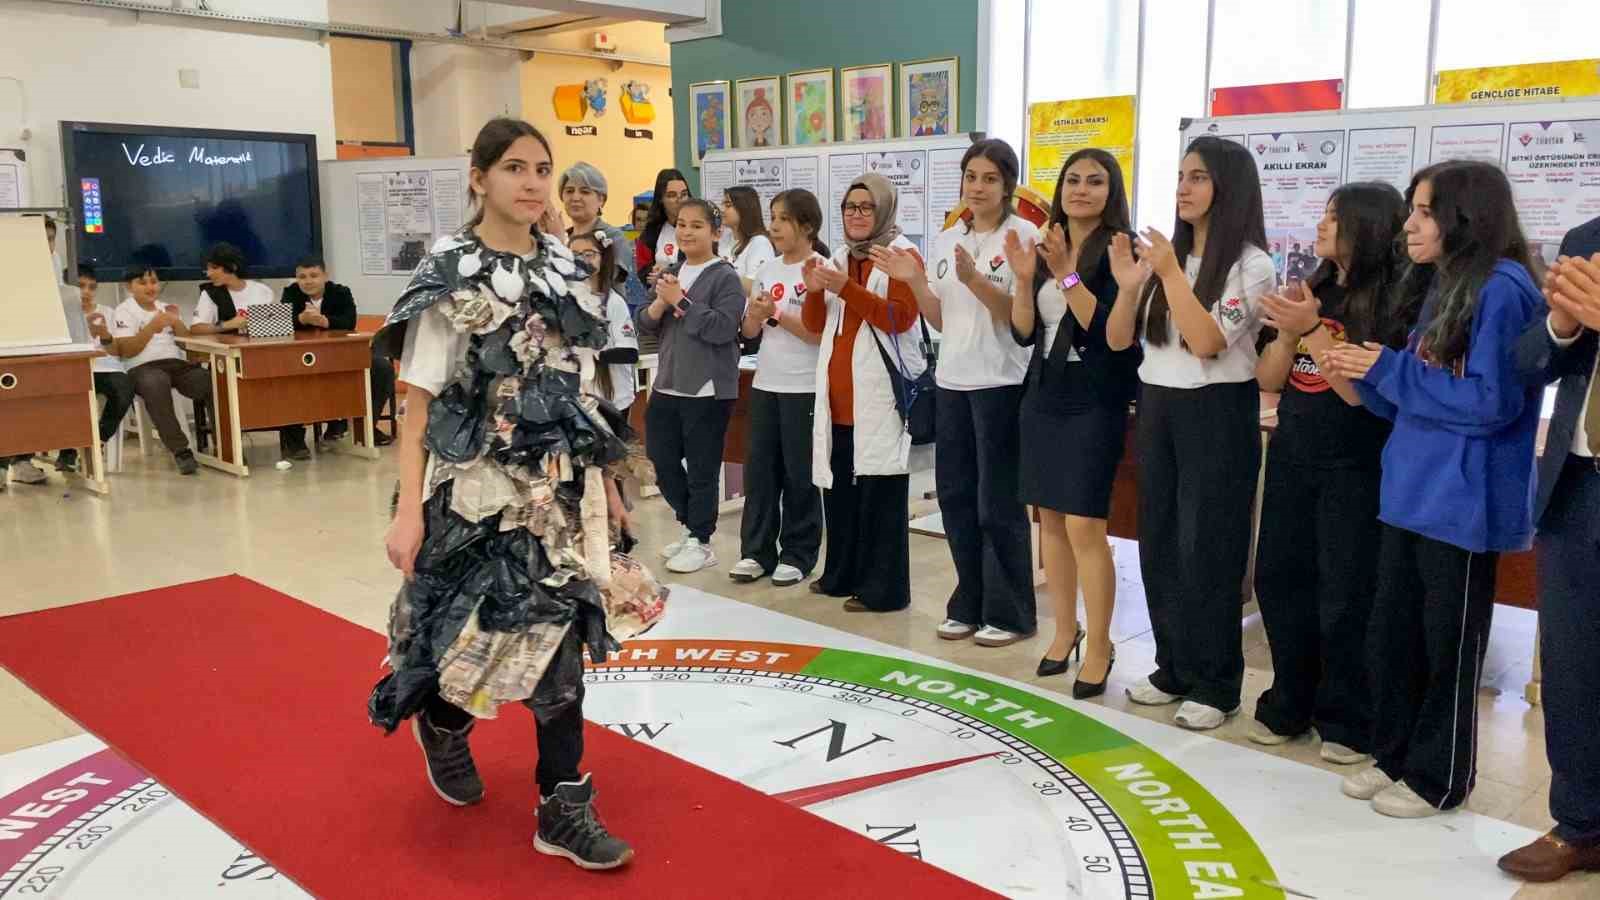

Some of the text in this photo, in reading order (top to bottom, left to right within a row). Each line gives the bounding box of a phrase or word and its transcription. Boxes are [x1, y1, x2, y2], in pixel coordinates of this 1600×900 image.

[571, 126, 593, 135] near
[121, 142, 175, 167] Vedic
[1263, 162, 1327, 171] AKILLI EKRAN
[674, 648, 791, 665] WEST
[585, 673, 626, 683] 310
[651, 672, 691, 682] 320
[713, 674, 753, 684] 330
[775, 680, 814, 693] 340
[832, 692, 872, 705] 350
[880, 670, 1054, 729] NORTH
[772, 718, 895, 762] N
[951, 727, 976, 740] 10
[993, 751, 1022, 765] 20
[1032, 781, 1062, 797] 30
[0, 772, 112, 840] WEST
[121, 790, 168, 812] 240
[1065, 816, 1093, 832] 40
[1104, 763, 1245, 900] NORTH EA
[65, 825, 113, 850] 230
[1083, 855, 1112, 873] 50
[18, 865, 64, 893] 220
